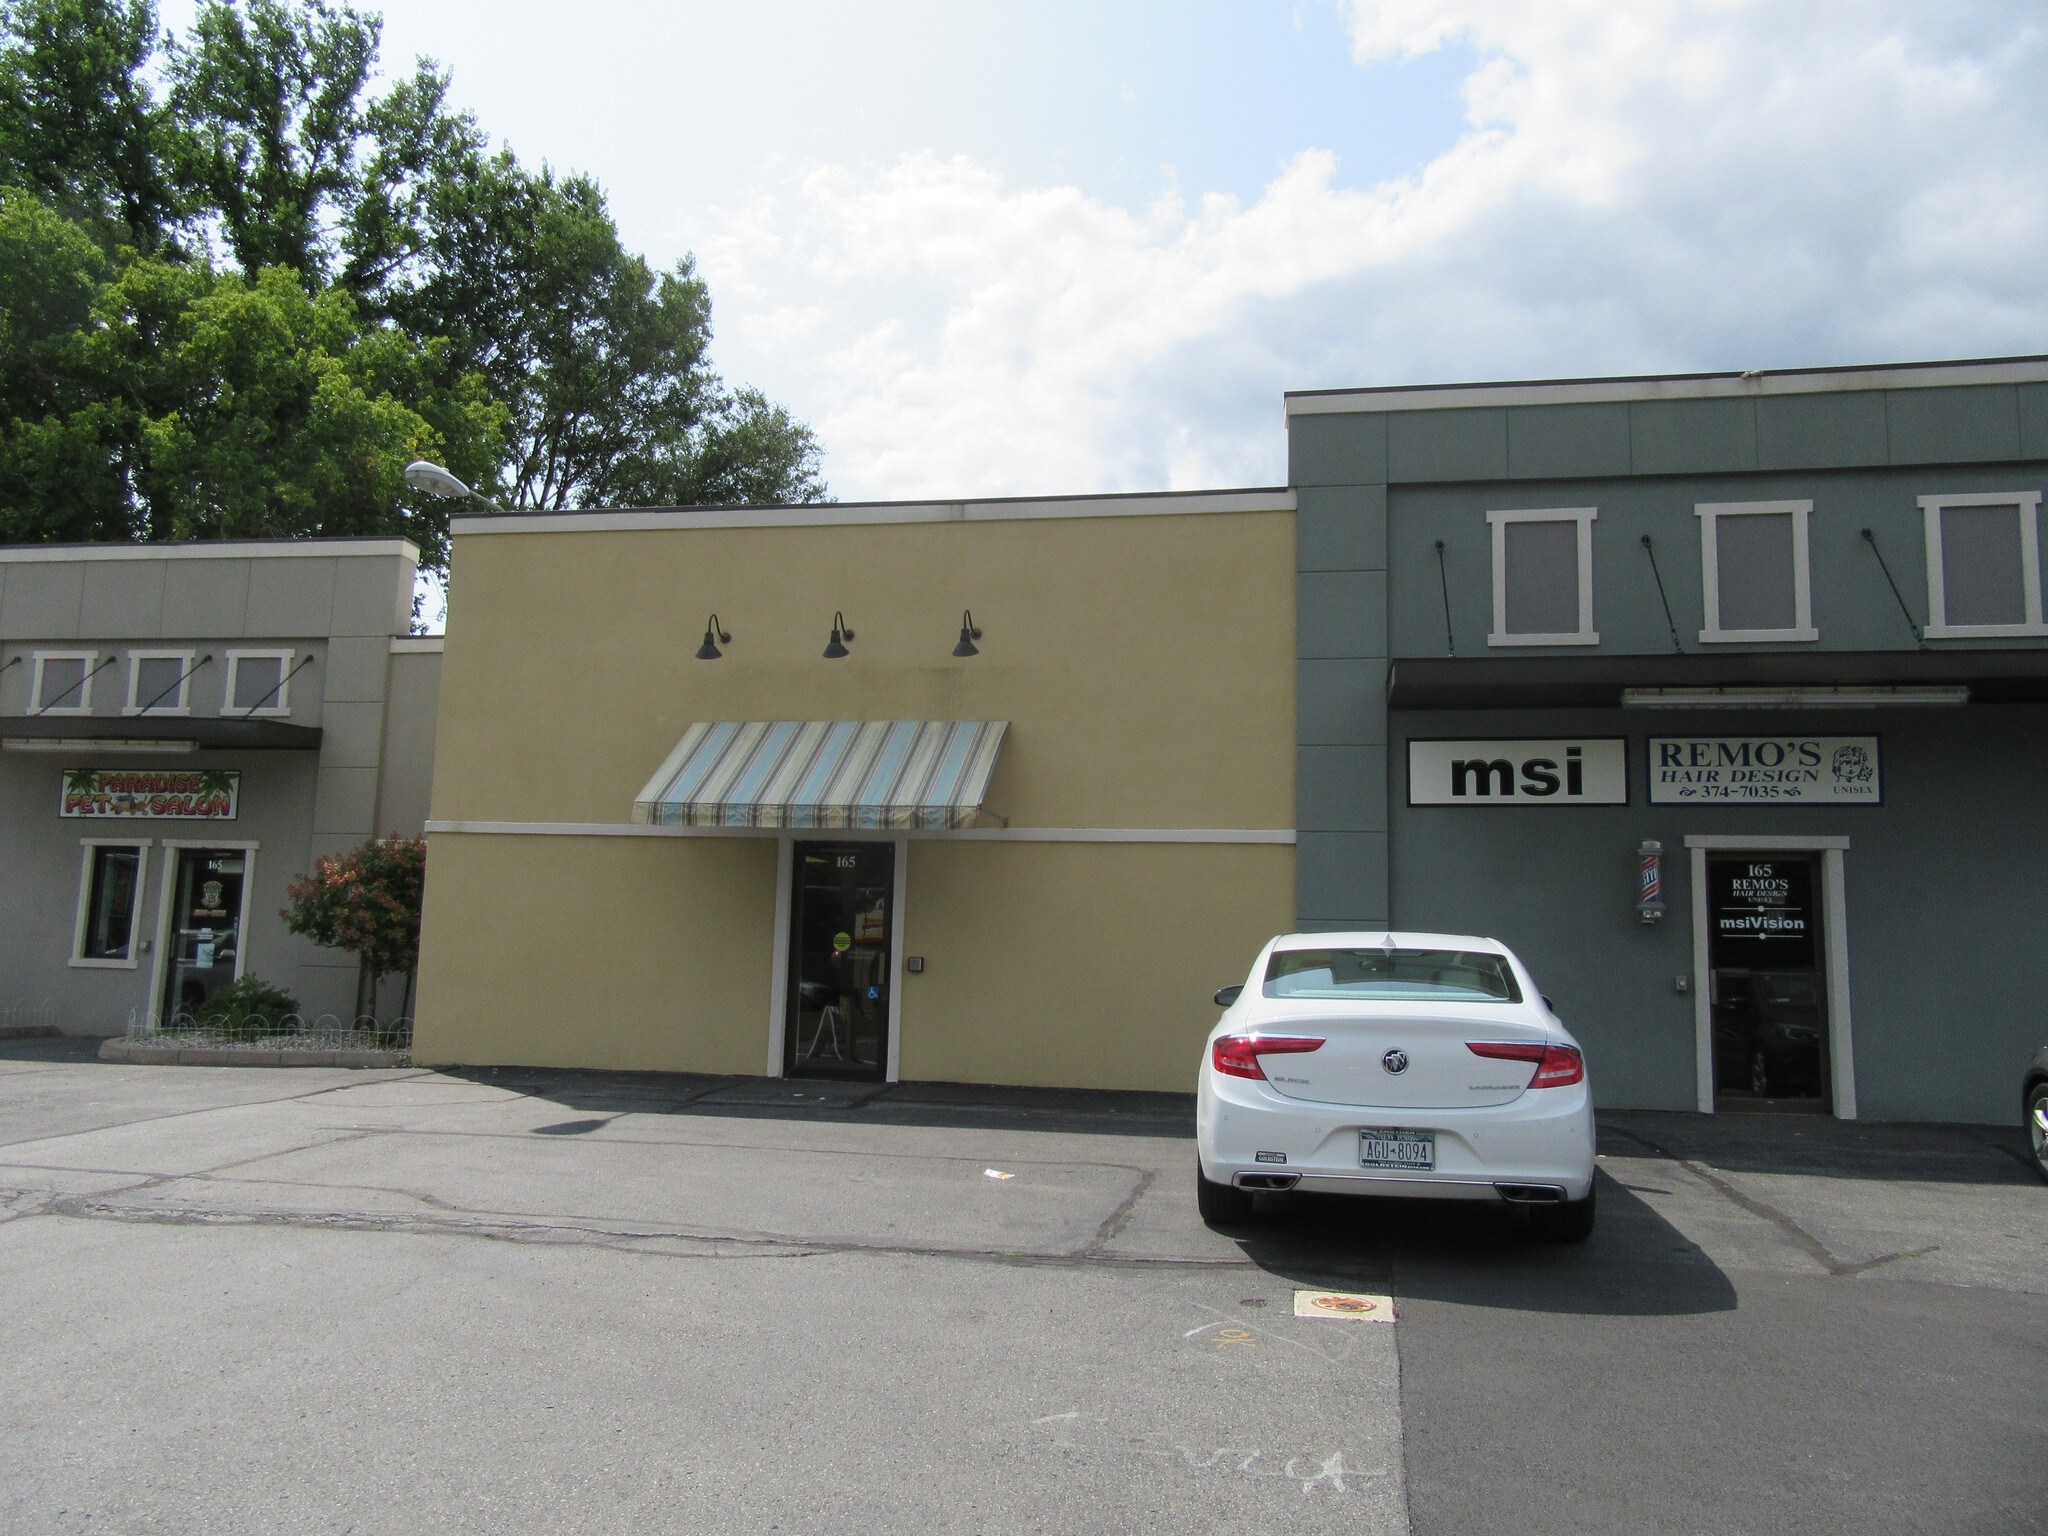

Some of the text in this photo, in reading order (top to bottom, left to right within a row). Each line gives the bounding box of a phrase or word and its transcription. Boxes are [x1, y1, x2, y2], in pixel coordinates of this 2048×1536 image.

[1658, 741, 1822, 768] REMO'S
[1451, 746, 1583, 797] msi
[1660, 768, 1820, 783] HAIR DESIGN
[97, 773, 201, 794] PARADISE
[1833, 785, 1874, 795] UNISEX
[1701, 785, 1780, 798] 374-7035
[65, 793, 232, 816] PET SALON
[208, 860, 223, 870] 165
[836, 856, 856, 868] 165
[1748, 864, 1772, 877] 165
[1732, 879, 1789, 890] REMO'S
[1720, 916, 1805, 929] msiVision
